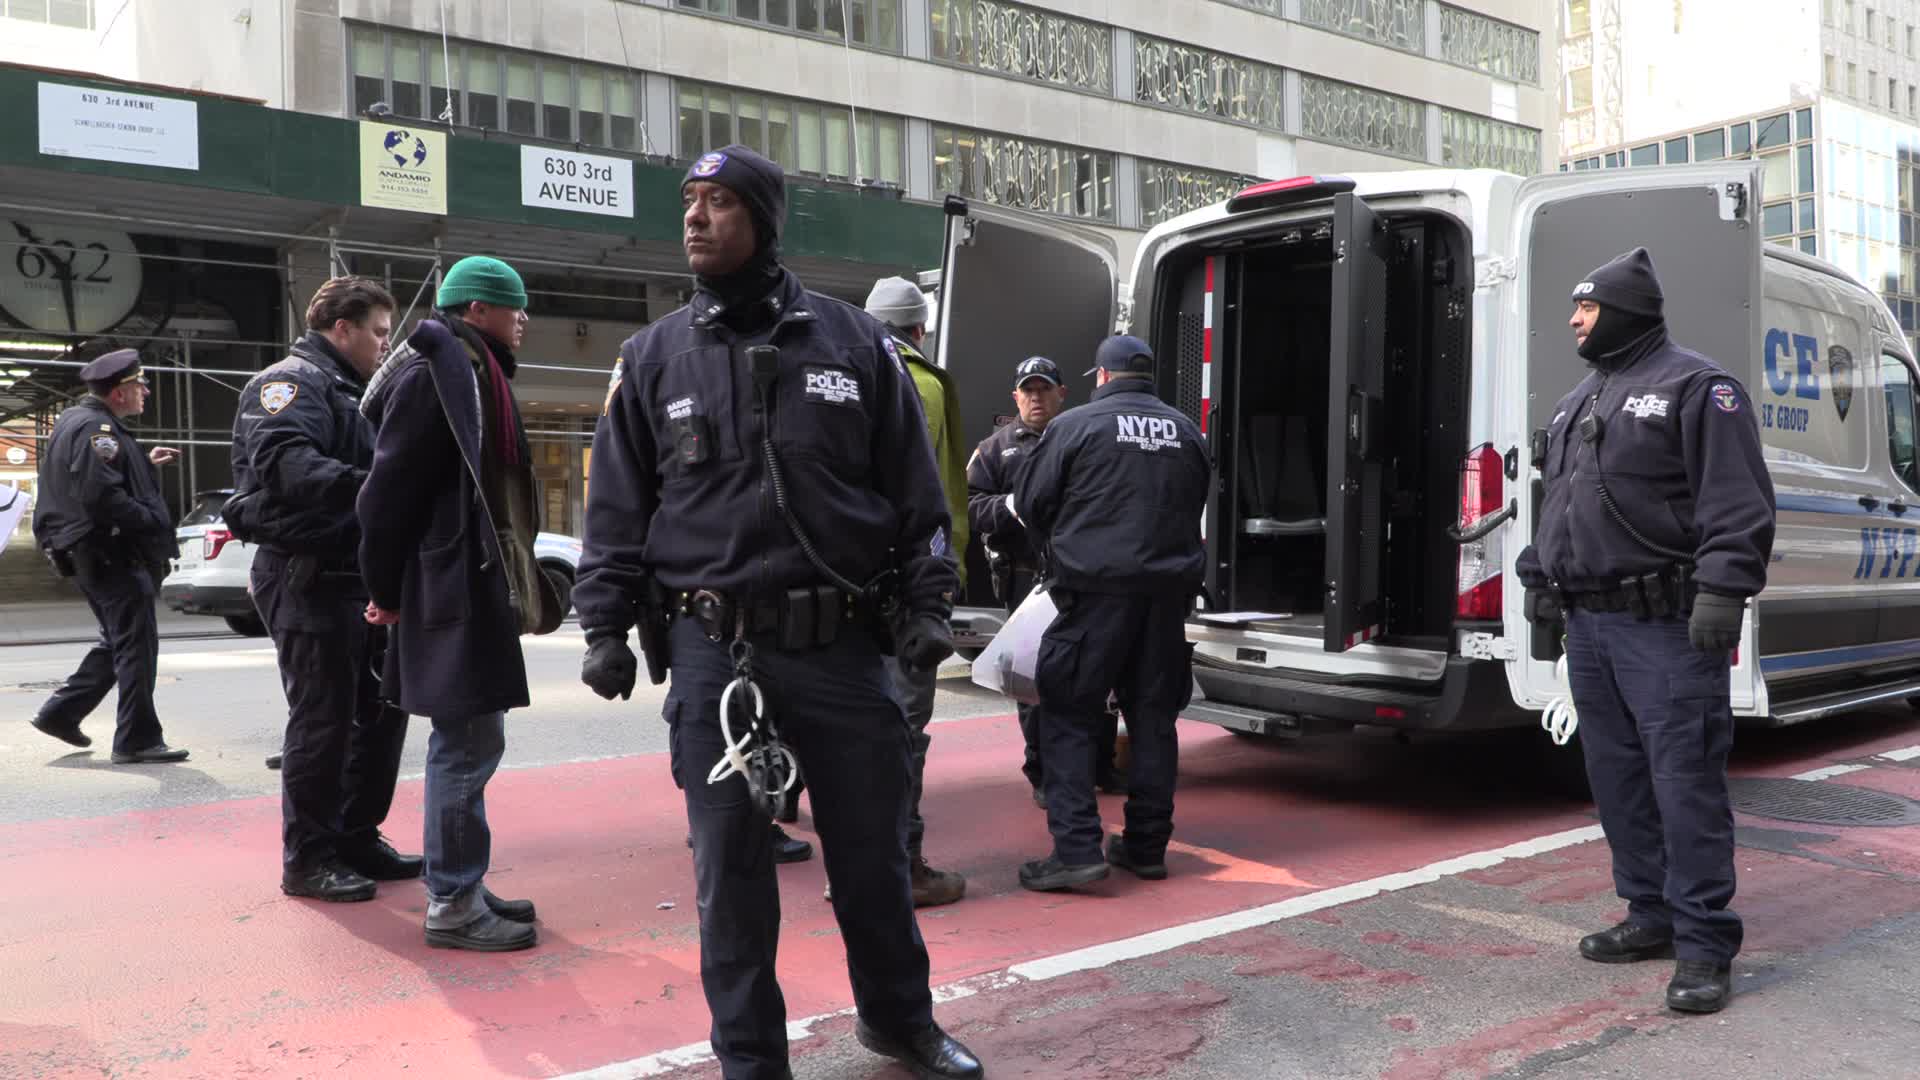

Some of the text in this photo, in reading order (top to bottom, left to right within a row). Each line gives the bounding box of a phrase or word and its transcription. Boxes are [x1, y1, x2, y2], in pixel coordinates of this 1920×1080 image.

[82, 94, 98, 105] 630
[123, 100, 155, 111] AVENUE
[544, 157, 612, 182] 630 3rd
[539, 182, 618, 207] AVENUE
[807, 373, 858, 394] POLICE
[1625, 396, 1669, 412] POLICE
[1117, 416, 1177, 440] NYPD
[1777, 405, 1809, 432] GROUP
[1854, 528, 1920, 578] NYP
